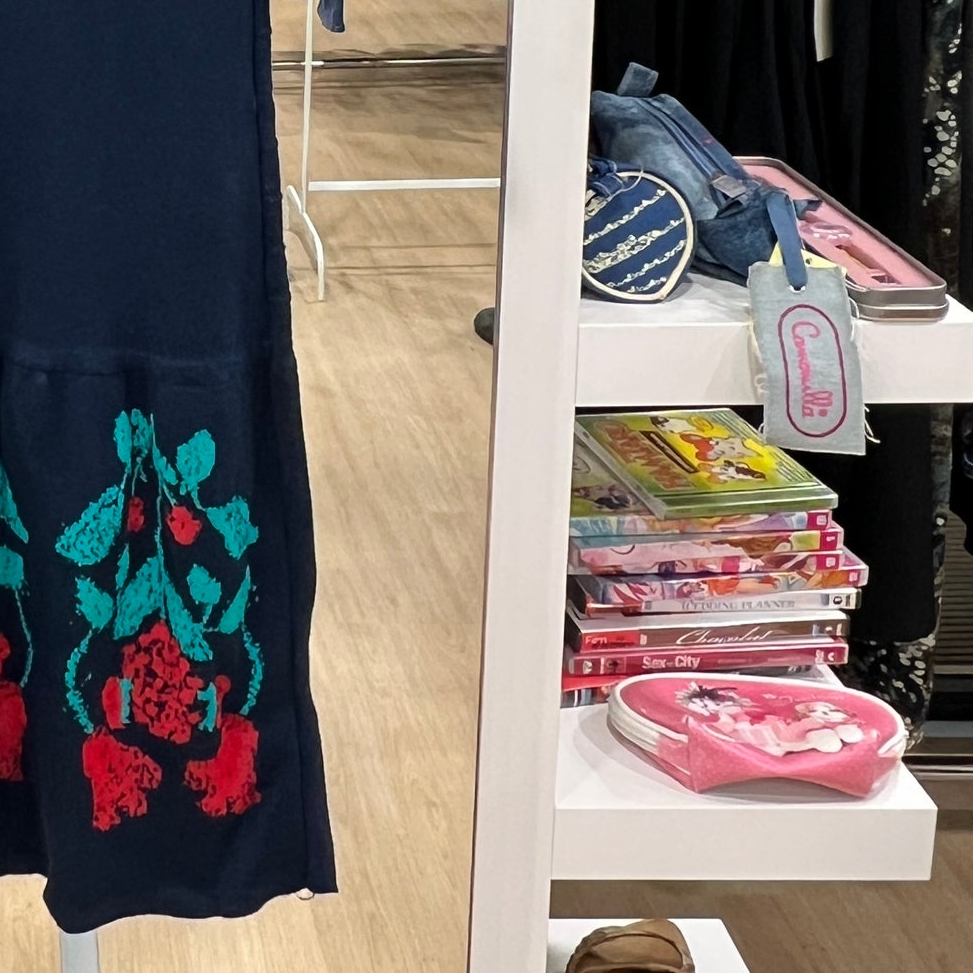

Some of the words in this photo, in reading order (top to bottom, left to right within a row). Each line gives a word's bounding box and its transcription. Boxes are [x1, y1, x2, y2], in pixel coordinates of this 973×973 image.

[741, 598, 795, 610] PLANNER
[642, 657, 667, 670] Sex
[673, 655, 701, 670] City
